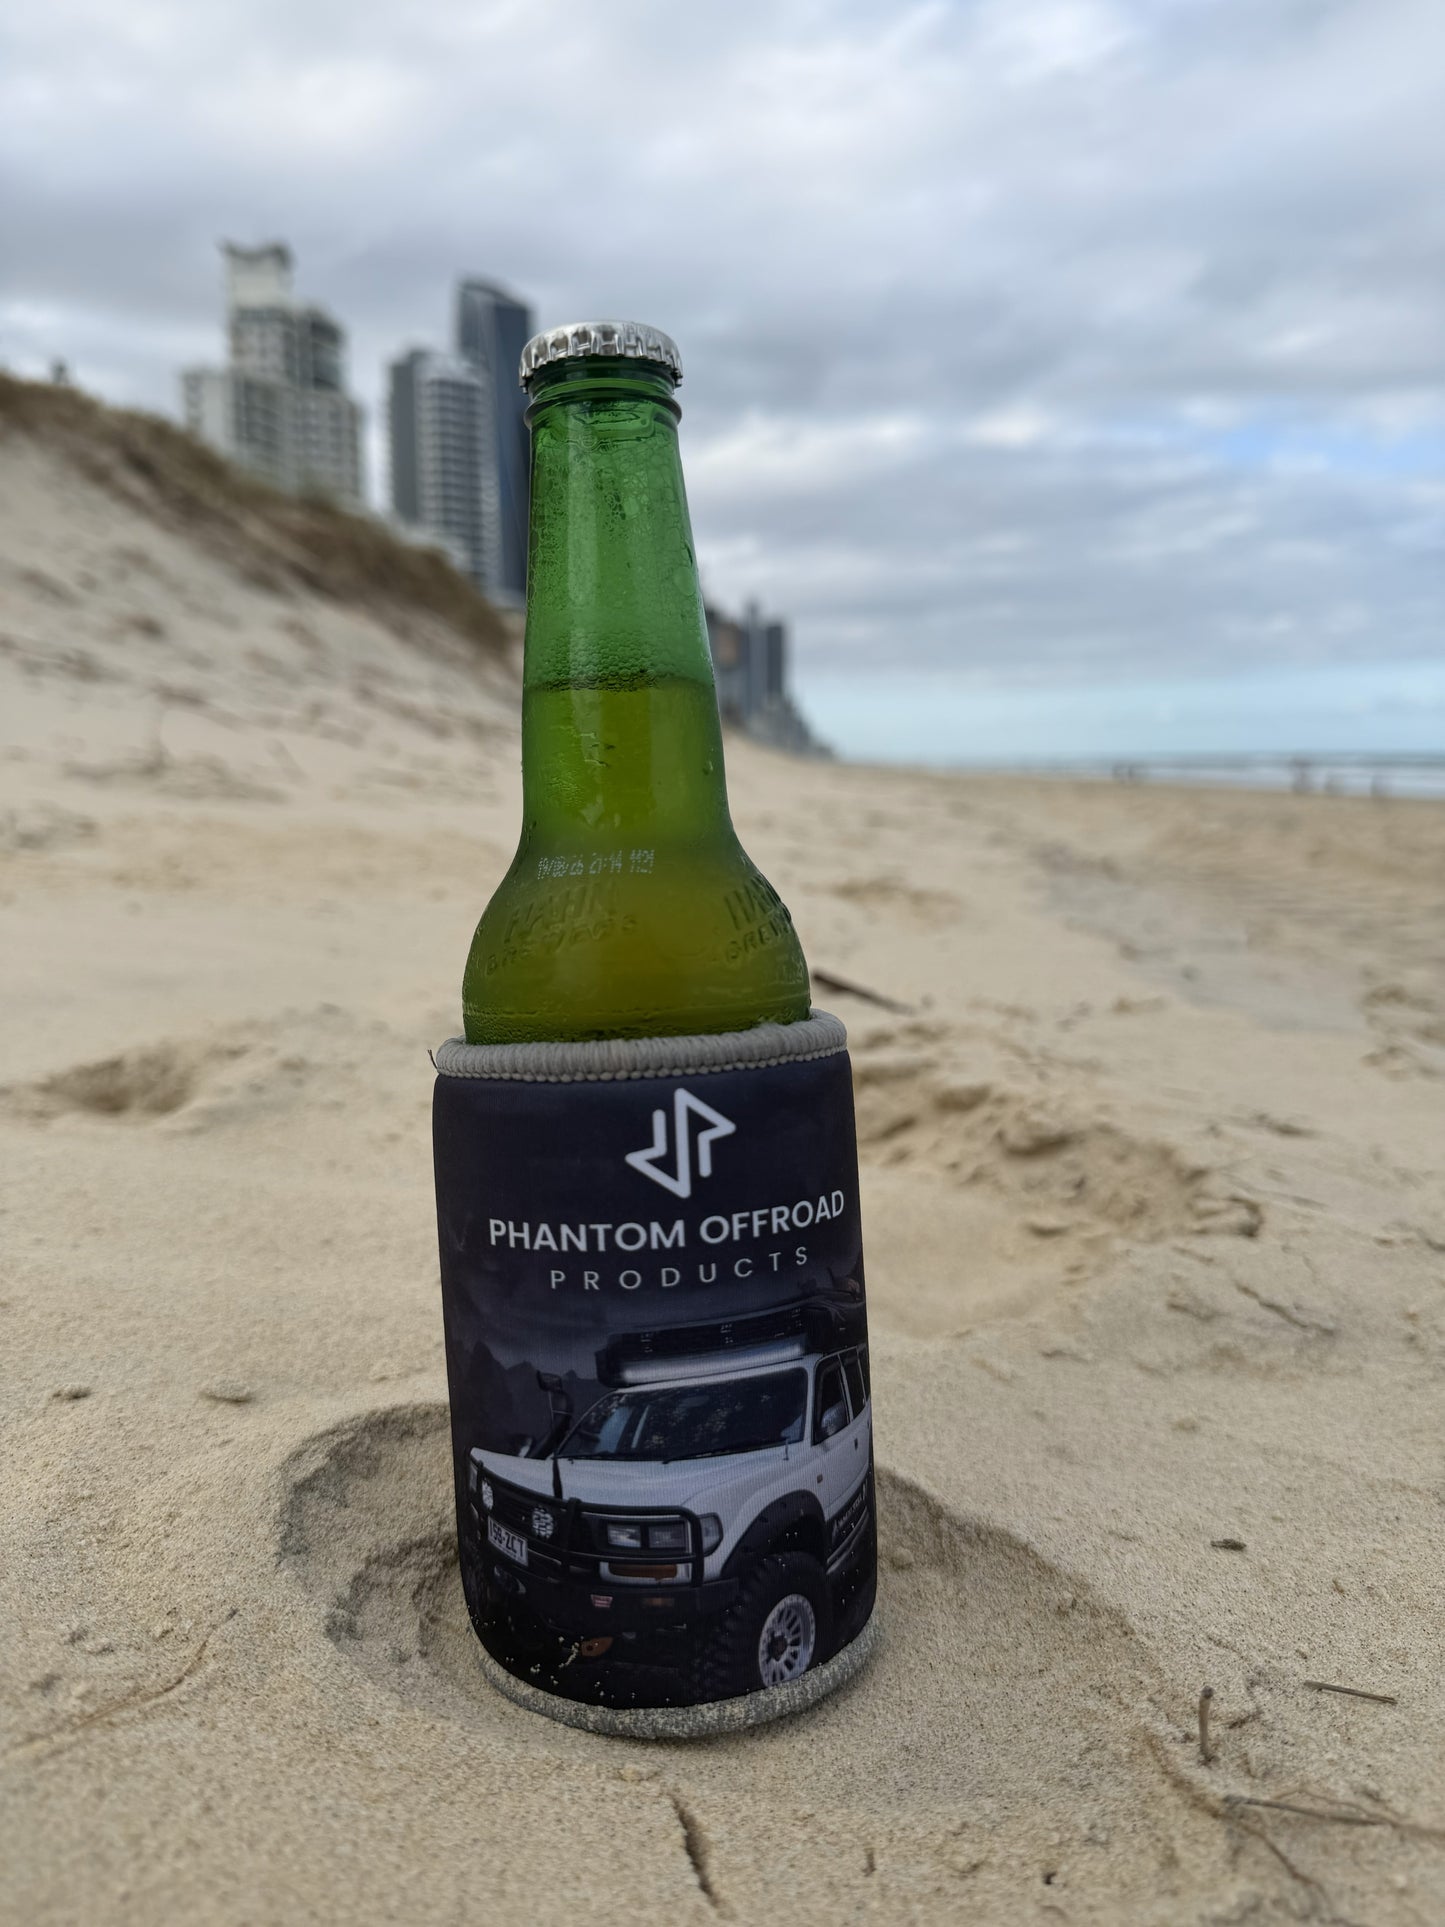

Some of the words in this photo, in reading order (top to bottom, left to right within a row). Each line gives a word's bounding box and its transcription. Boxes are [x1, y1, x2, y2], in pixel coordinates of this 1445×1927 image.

[488, 1217, 686, 1253] PHANTOM
[699, 1189, 845, 1245] OFFROAD
[550, 1245, 808, 1290] PRODUCTS
